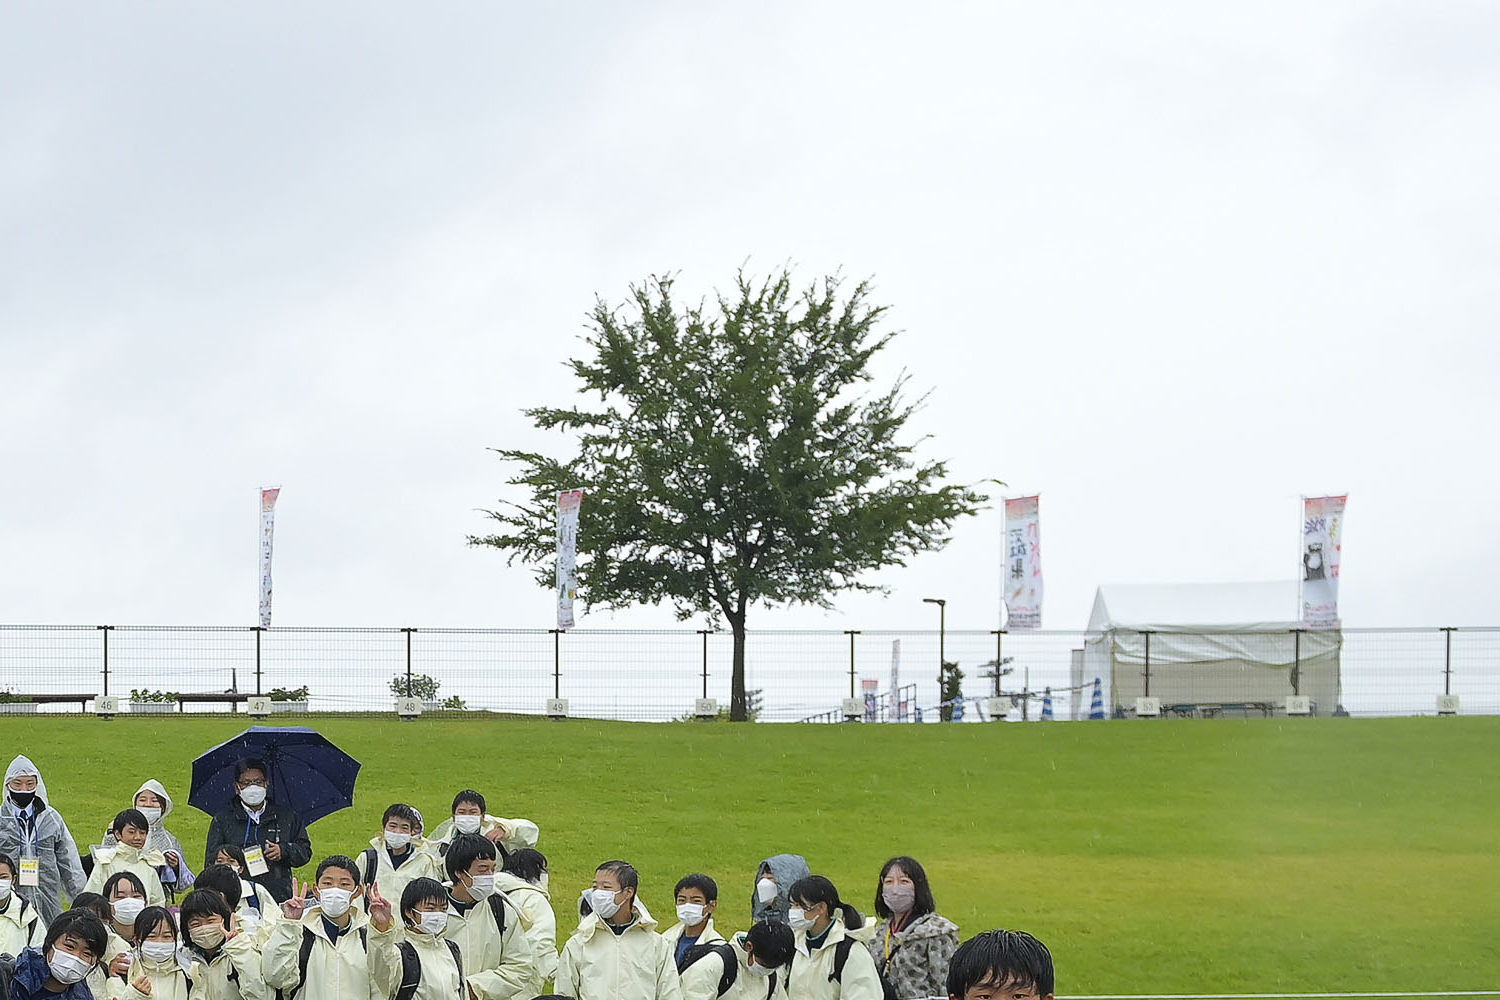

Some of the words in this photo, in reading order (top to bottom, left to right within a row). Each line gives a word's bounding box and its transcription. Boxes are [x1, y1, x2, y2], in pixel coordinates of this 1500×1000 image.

[100, 699, 112, 711] 46
[253, 701, 265, 712] 47
[404, 702, 416, 713] 48
[552, 702, 563, 713] 49
[700, 702, 712, 713] 50
[848, 702, 858, 713] 51
